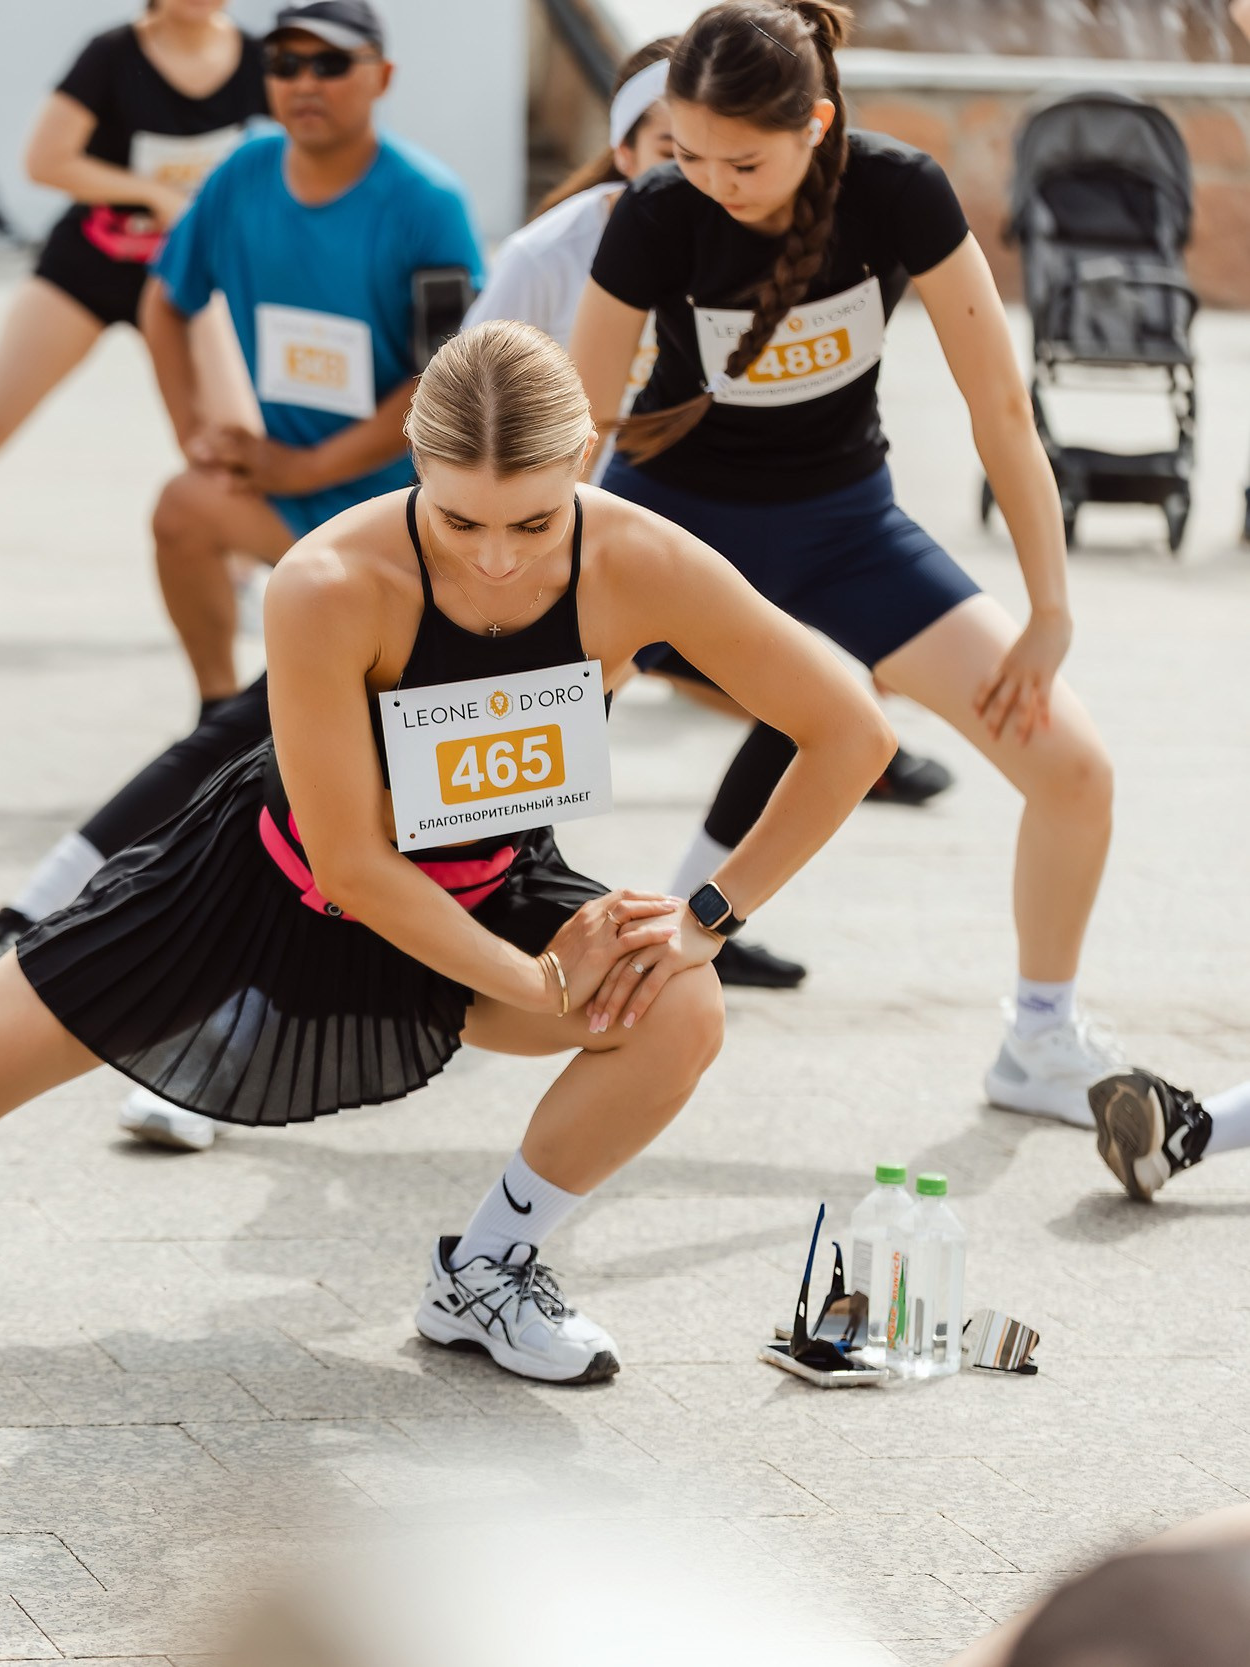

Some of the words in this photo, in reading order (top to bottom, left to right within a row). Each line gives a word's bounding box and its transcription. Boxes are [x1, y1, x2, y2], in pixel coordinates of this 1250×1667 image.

[754, 335, 842, 379] 488
[403, 702, 480, 729] LEONE
[519, 685, 584, 711] D'ORO
[451, 734, 552, 793] 465
[418, 795, 554, 831] БЛАГОТВОРИТЕЛЬНЫЙ
[556, 791, 592, 807] ЗАБЕГ
